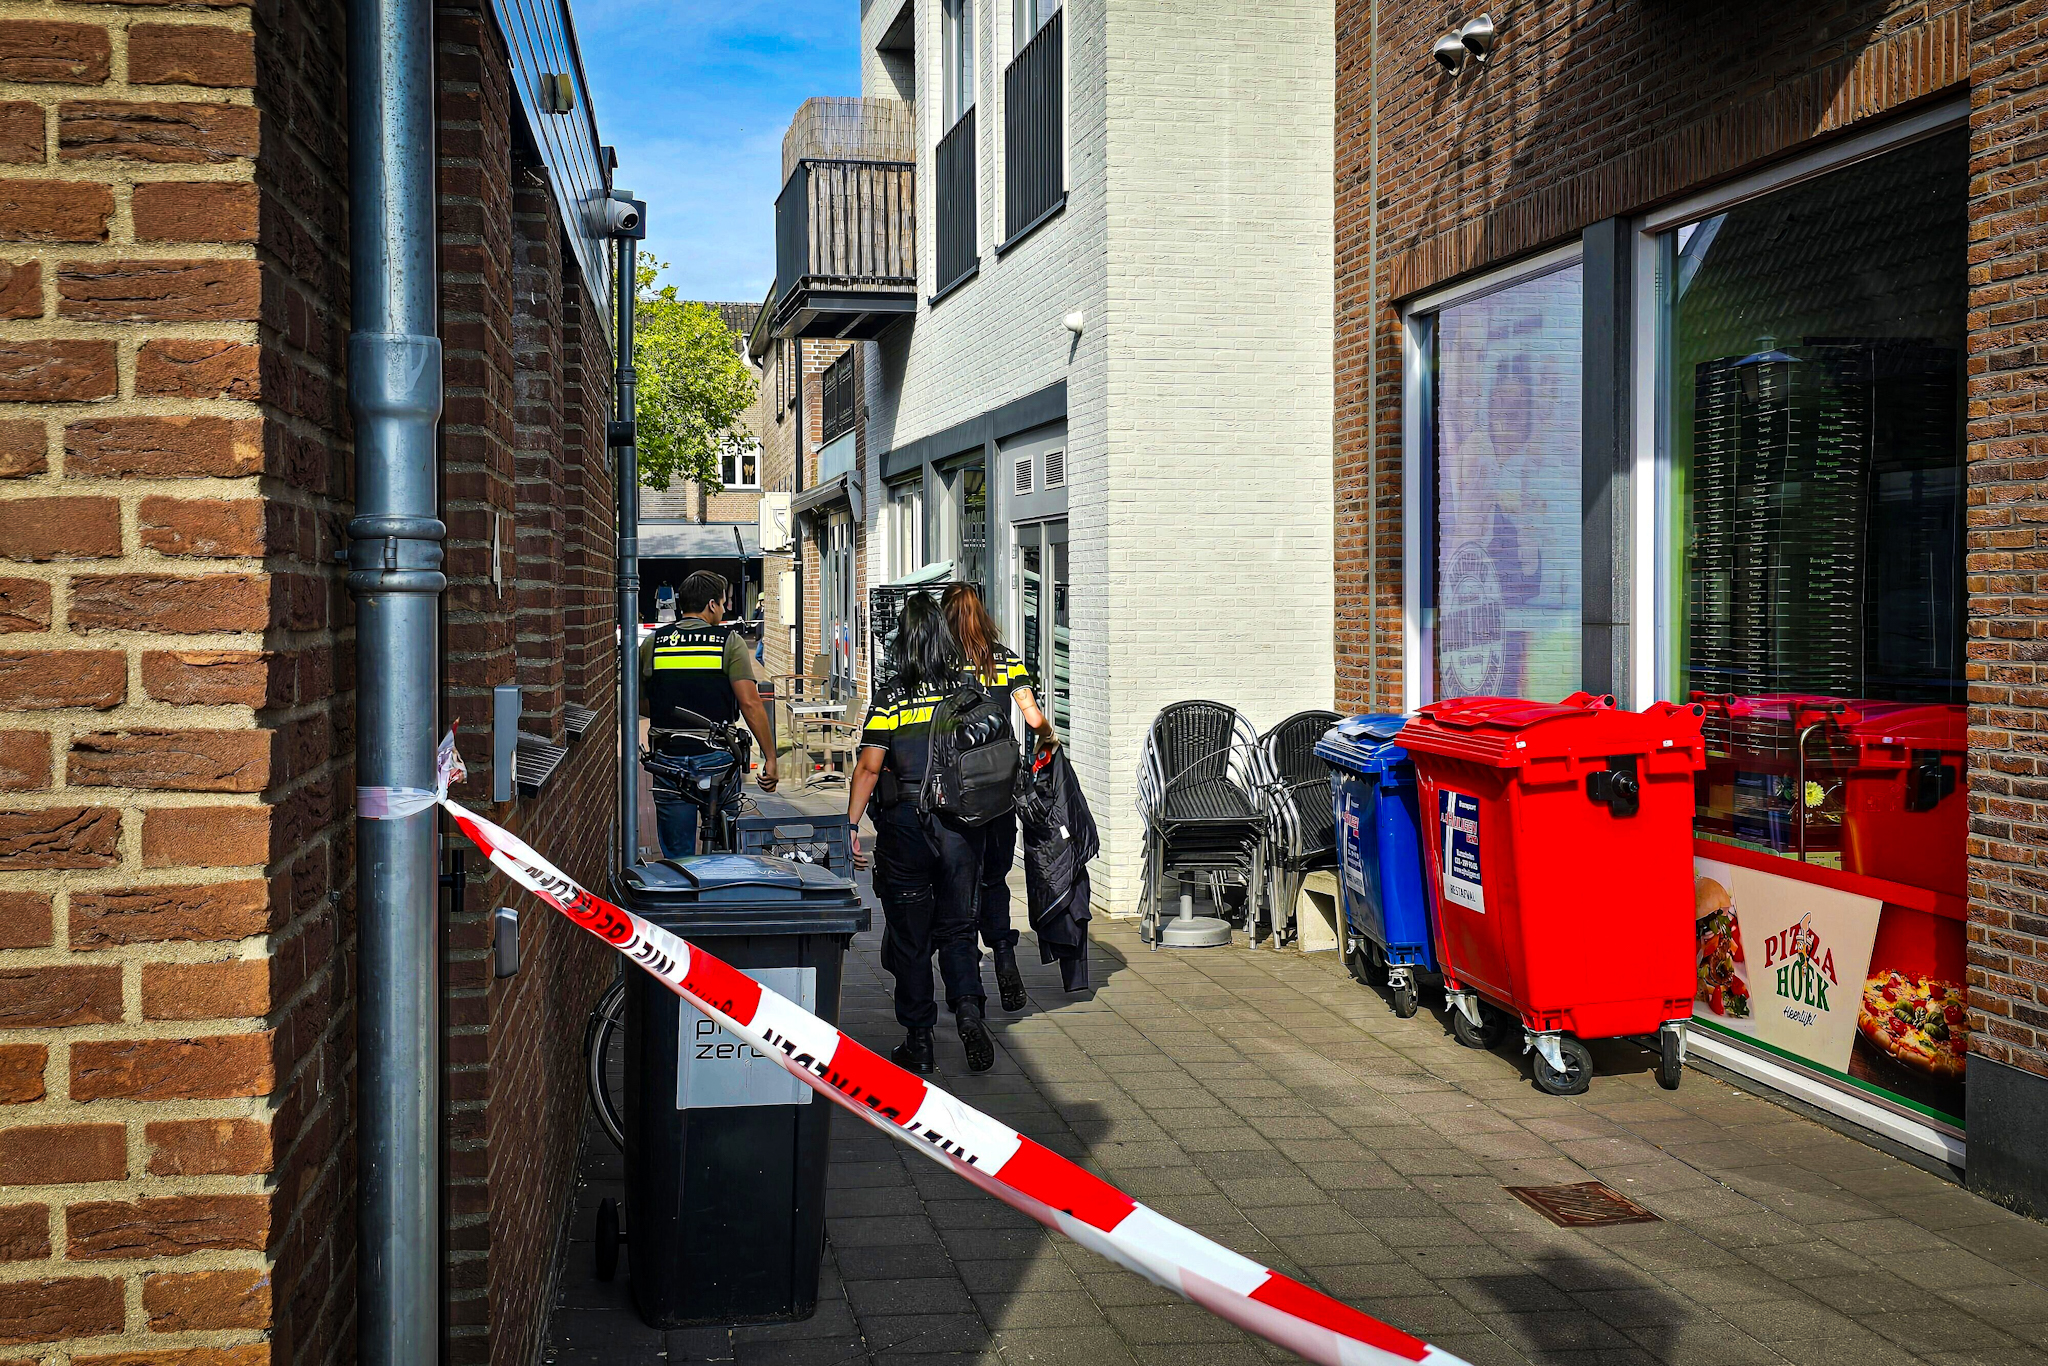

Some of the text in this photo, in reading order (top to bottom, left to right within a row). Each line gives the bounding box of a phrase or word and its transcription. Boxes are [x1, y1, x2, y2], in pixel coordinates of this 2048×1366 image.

[662, 632, 716, 646] POLITIE
[1764, 922, 1838, 986] PIZZA
[1776, 960, 1830, 1012] HOEK
